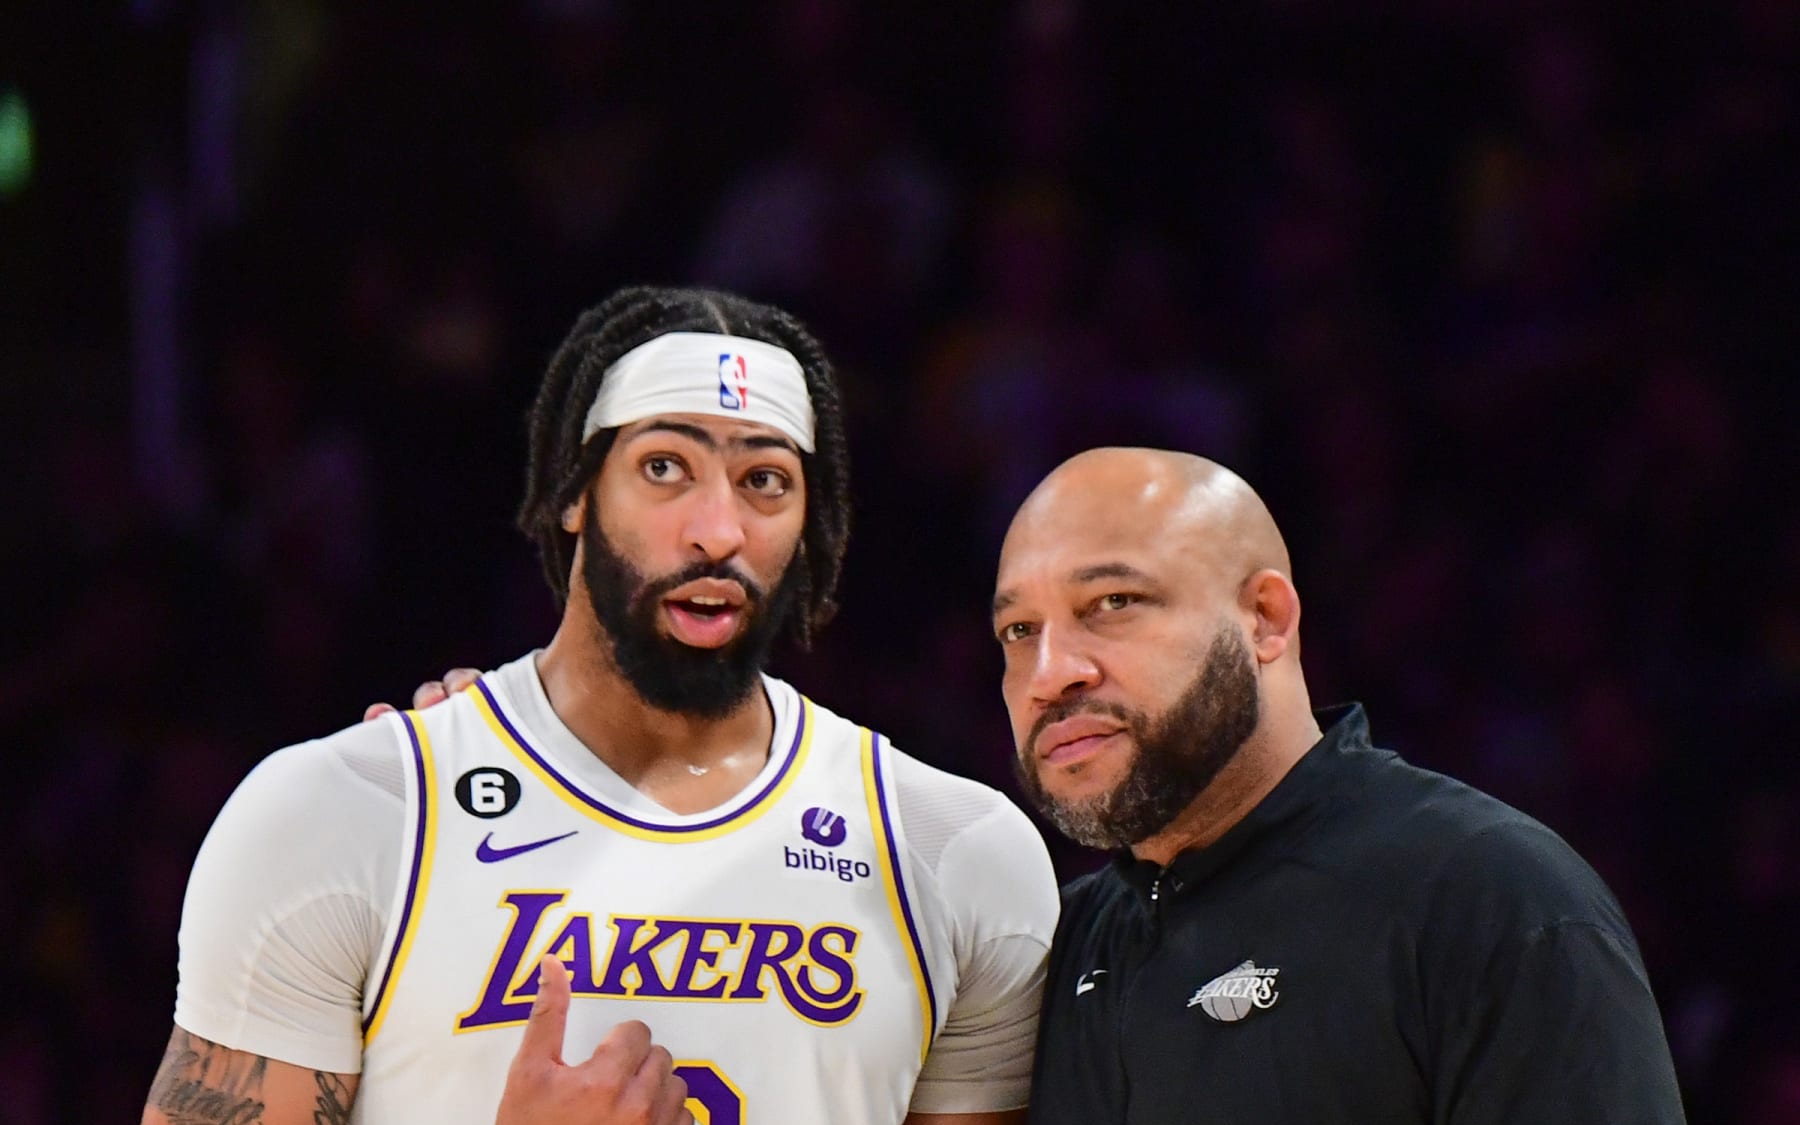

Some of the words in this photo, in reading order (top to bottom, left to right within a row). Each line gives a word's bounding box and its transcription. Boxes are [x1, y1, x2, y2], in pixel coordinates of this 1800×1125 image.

[470, 772, 507, 814] 6
[784, 845, 871, 883] bibigo
[453, 888, 868, 1034] LAKERS
